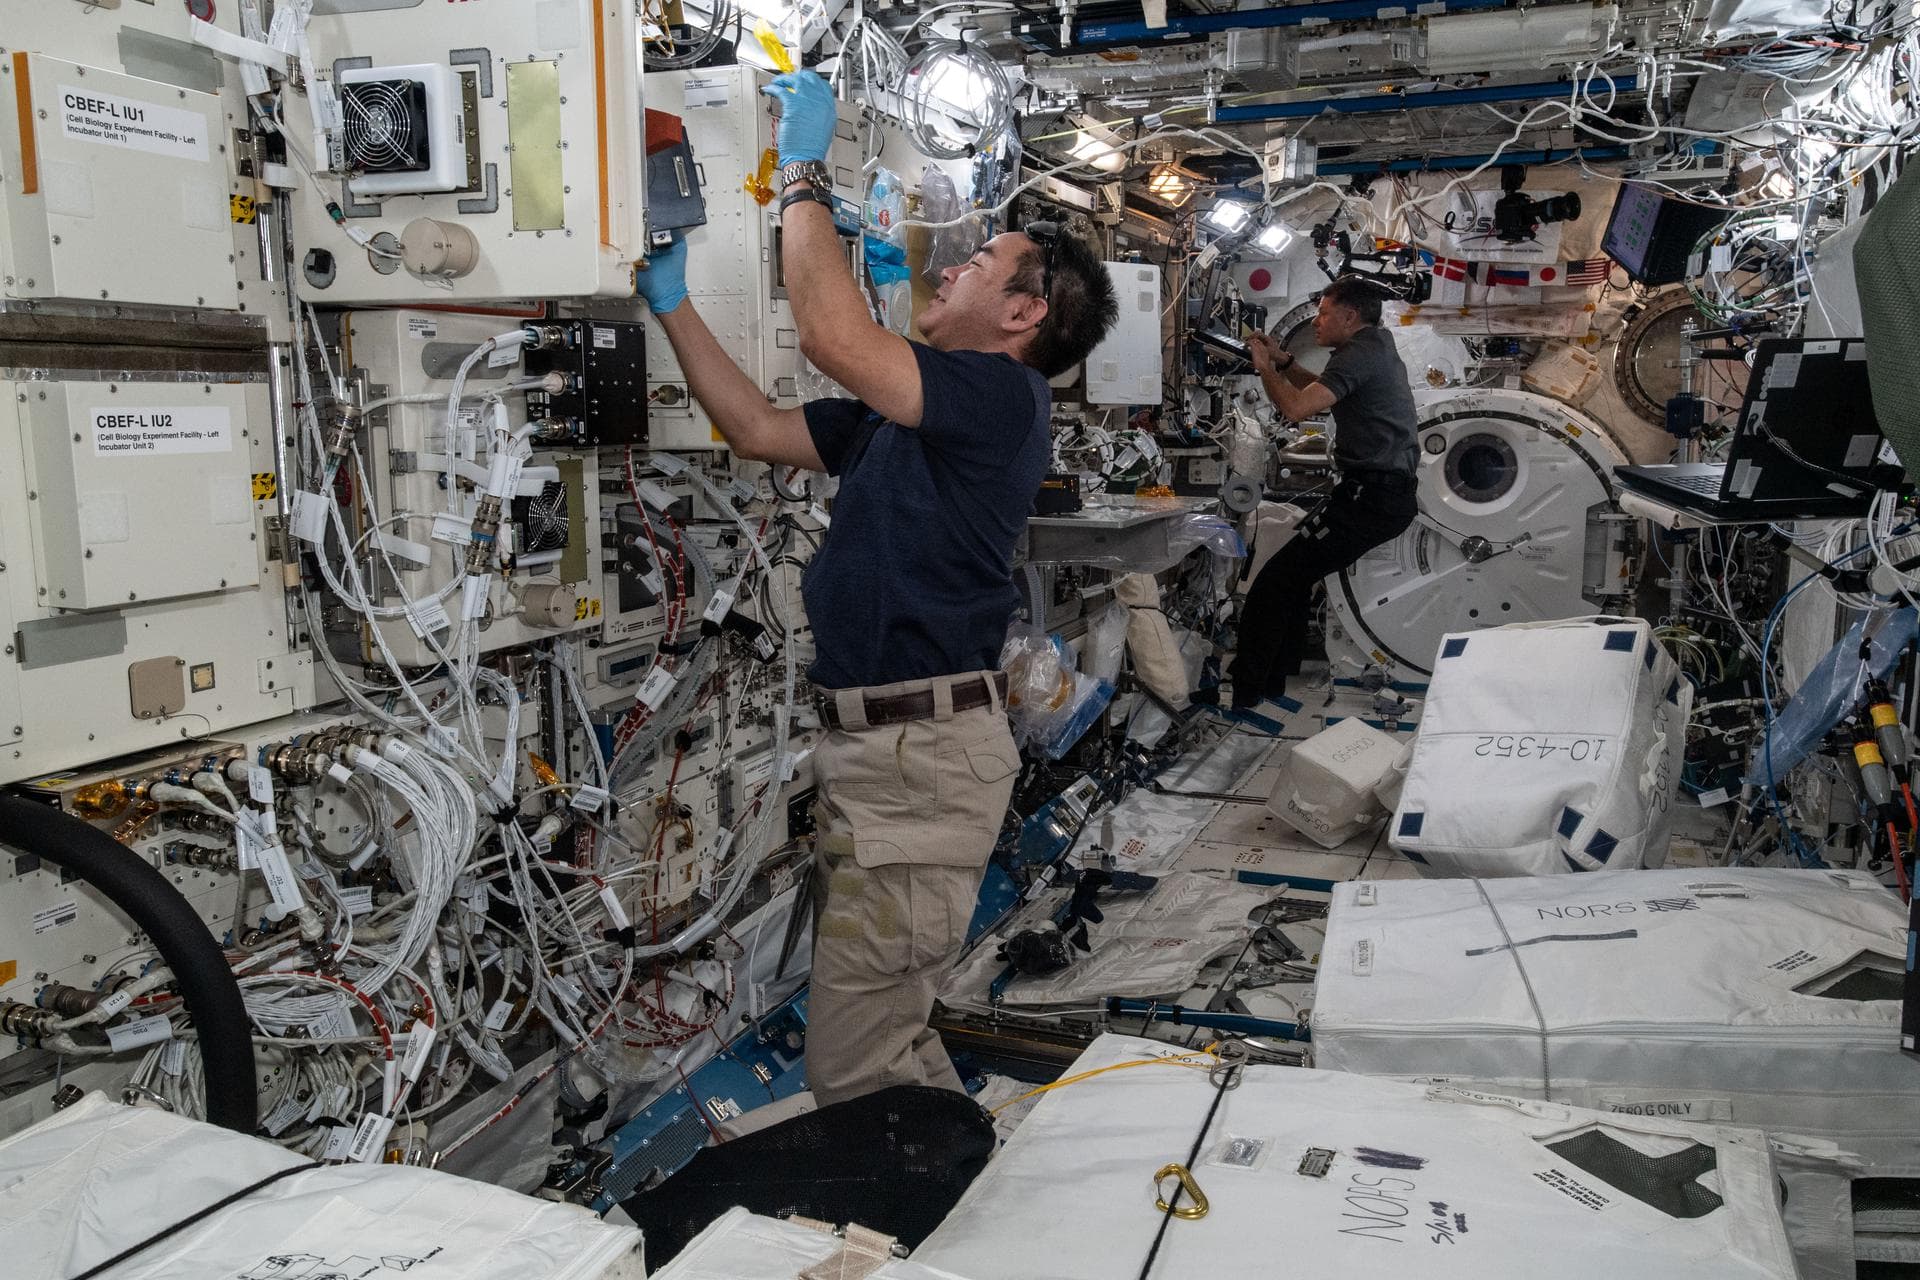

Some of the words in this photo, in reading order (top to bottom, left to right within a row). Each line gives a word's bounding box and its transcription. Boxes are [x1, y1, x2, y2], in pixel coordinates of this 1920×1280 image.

[65, 94, 120, 117] CBEF-L
[124, 106, 145, 122] IU1
[66, 113, 84, 124] (Cell
[85, 116, 113, 130] Biology
[114, 122, 153, 137] Experiment
[154, 130, 178, 143] Facility
[183, 136, 196, 145] Left
[67, 124, 102, 138] Incubator
[104, 130, 119, 141] Unit
[121, 133, 128, 143] 1)
[96, 415, 148, 428] CBEF-L
[151, 414, 172, 427] IU2
[97, 433, 114, 442] (Cell
[115, 432, 141, 442] Biology
[142, 432, 179, 441] Experiment
[180, 431, 203, 440] Facility
[98, 442, 131, 451] Incubator
[133, 442, 147, 450] Unit
[147, 442, 155, 450] 2)
[1537, 900, 1636, 921] NORS
[1645, 1104, 1655, 1116] G
[1657, 1103, 1692, 1115] ONLY
